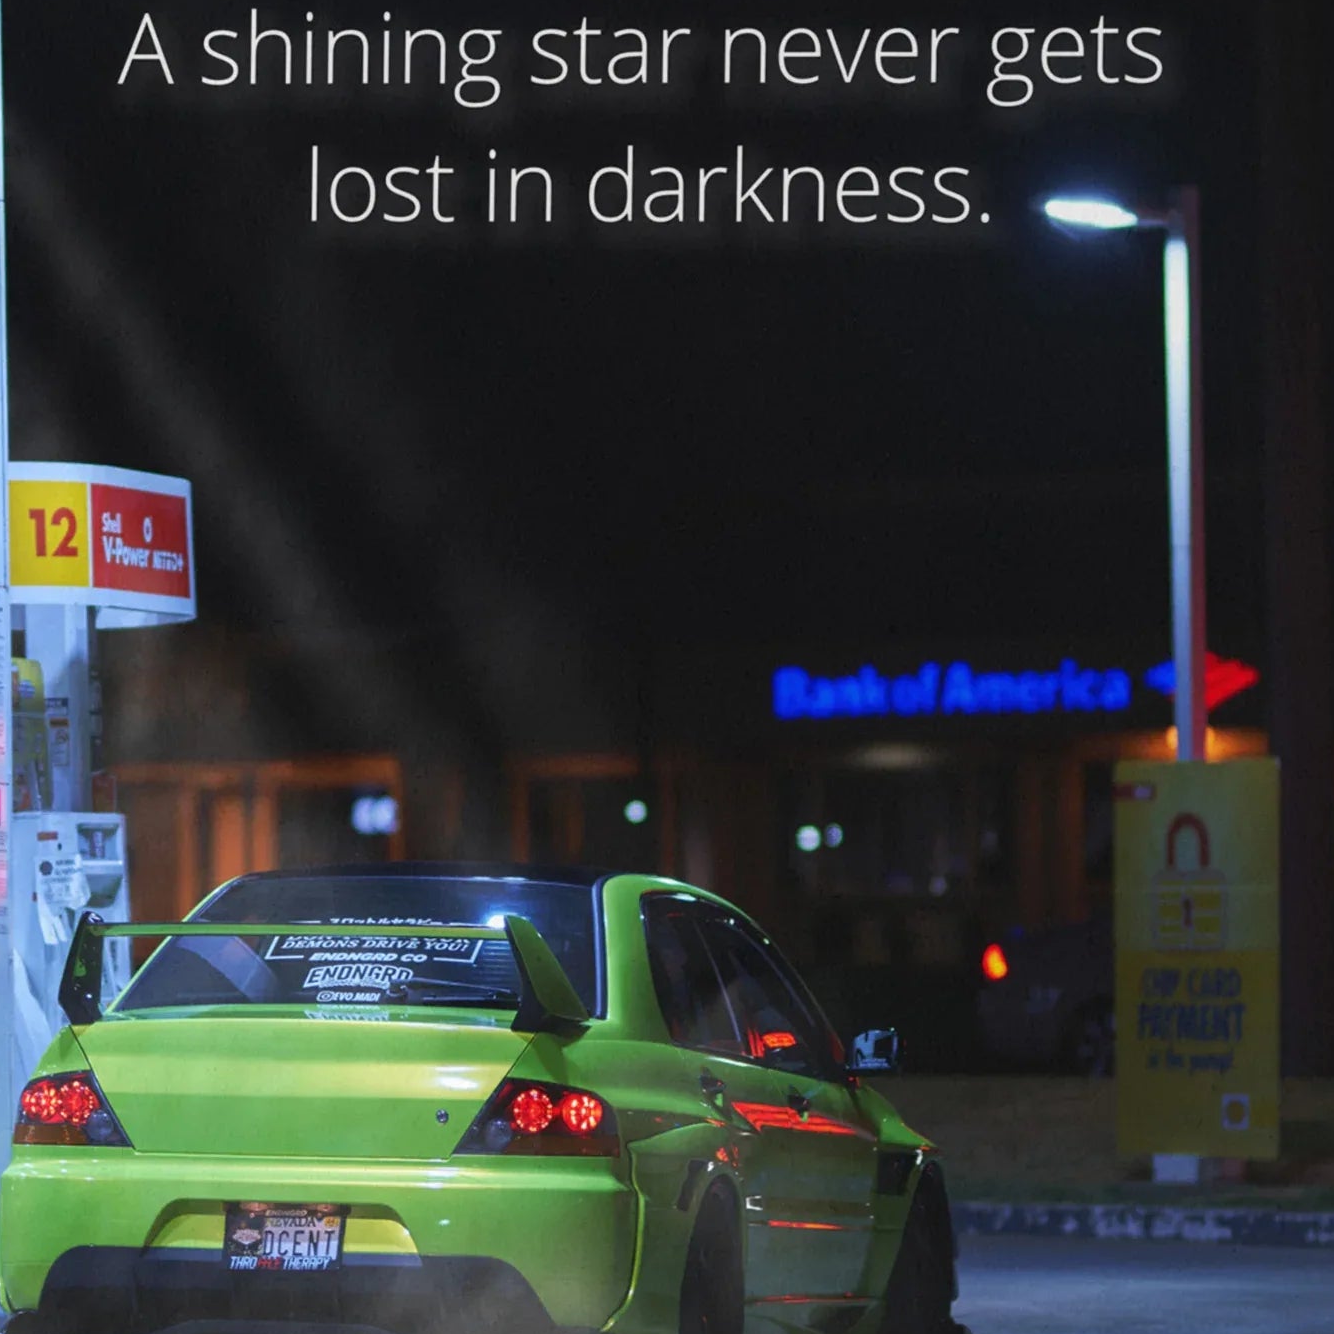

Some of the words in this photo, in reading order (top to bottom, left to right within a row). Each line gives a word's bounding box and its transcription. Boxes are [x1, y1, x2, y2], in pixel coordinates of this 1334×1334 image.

[117, 12, 175, 85] A
[201, 8, 503, 108] shining
[530, 16, 692, 85] star
[723, 27, 960, 85] never
[986, 15, 1163, 107] gets
[310, 145, 455, 223] lost
[488, 148, 552, 223] in
[587, 145, 991, 224] darkness.
[29, 507, 78, 557] 12
[102, 535, 150, 568] V-Power
[773, 665, 890, 719] Bank
[891, 661, 940, 716] of
[942, 658, 1131, 714] America
[281, 939, 360, 950] DEMONS
[362, 939, 420, 950] DRIVE
[308, 953, 398, 963] ENDNGRD
[400, 953, 429, 963] CO
[303, 964, 414, 986] ENDNGRD
[1187, 967, 1242, 999] CARD
[1138, 1003, 1247, 1042] PAYMENT
[266, 1217, 316, 1228] NEVADA
[263, 1230, 335, 1257] DCENT
[283, 1256, 332, 1271] THERAPY
